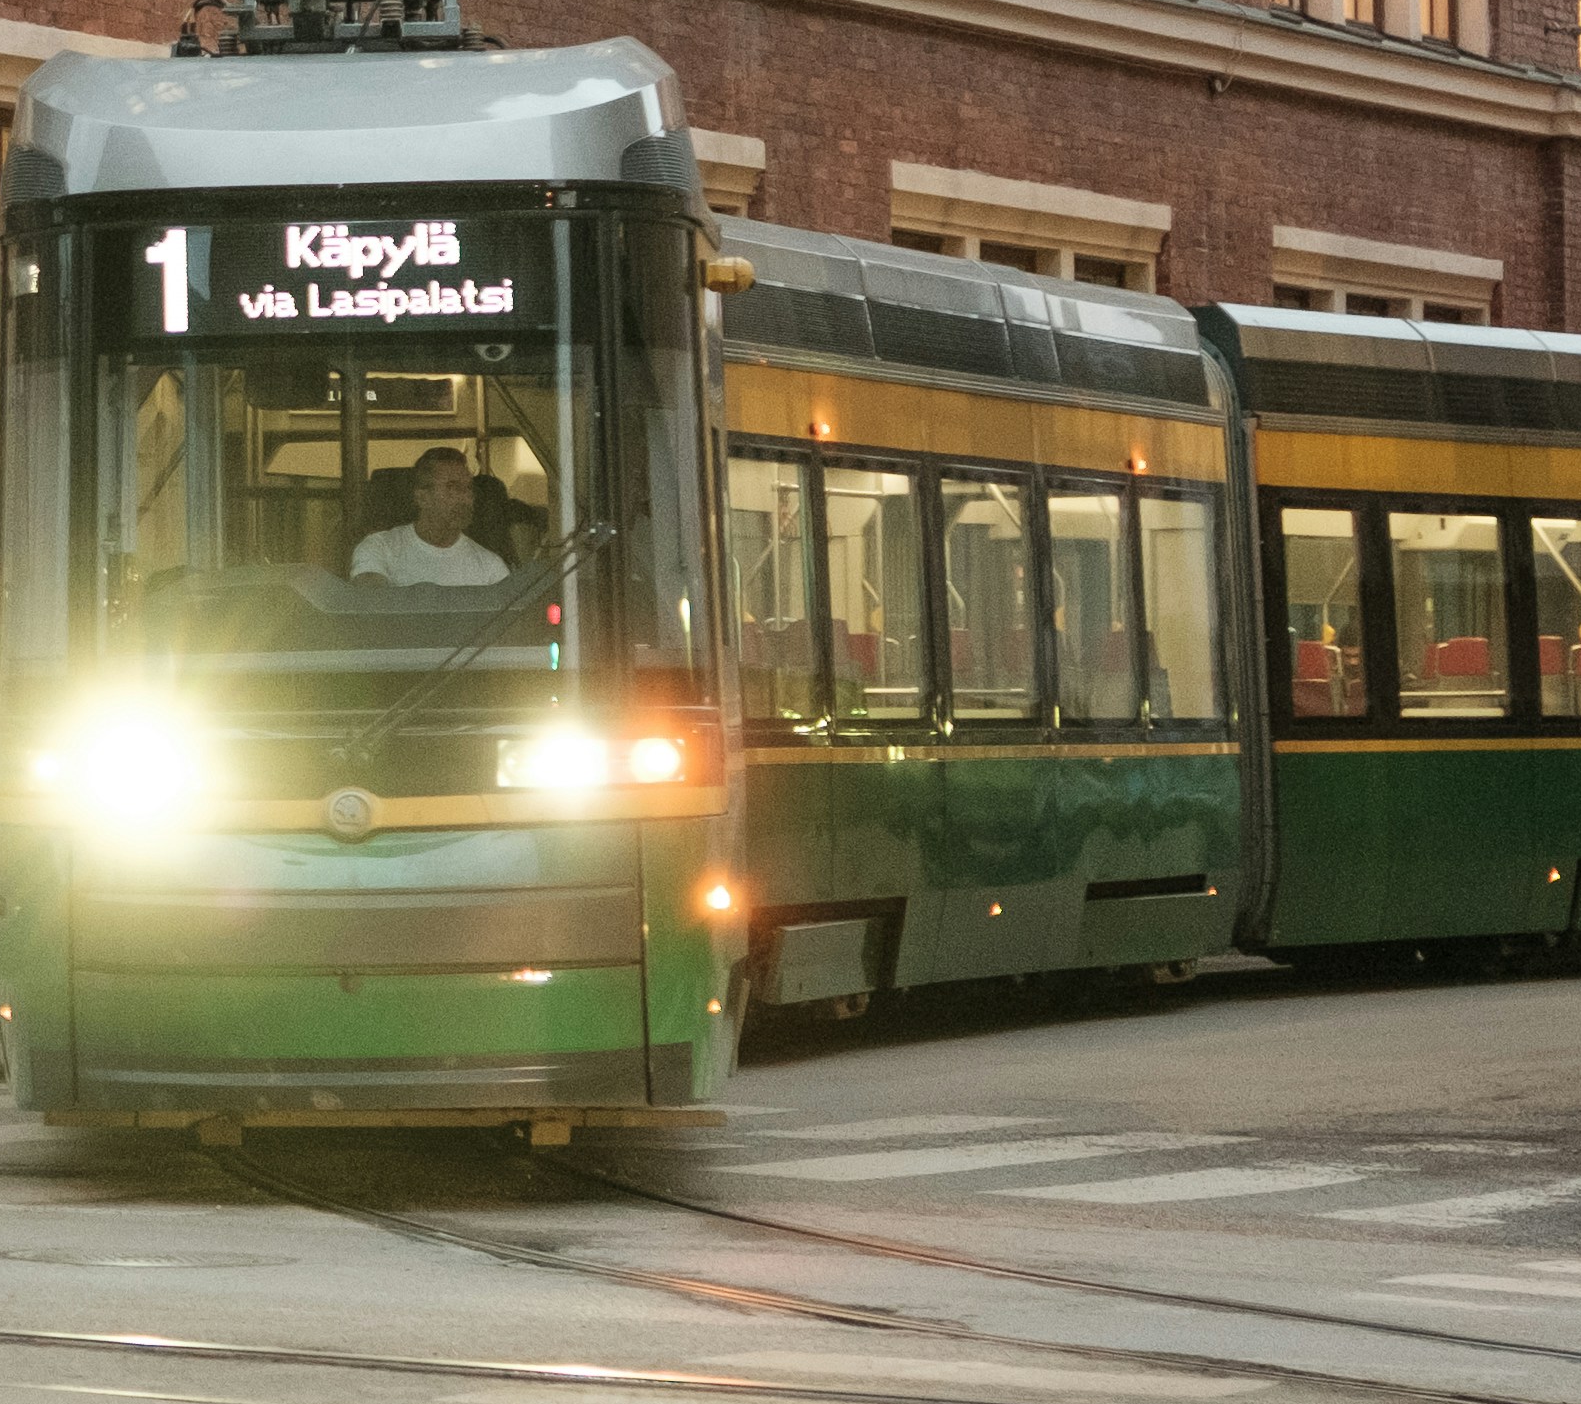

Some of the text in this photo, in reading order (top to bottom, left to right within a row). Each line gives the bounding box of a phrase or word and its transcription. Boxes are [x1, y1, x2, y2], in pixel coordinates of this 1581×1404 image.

[285, 222, 461, 279] Käpylä
[145, 227, 189, 333] 1
[239, 278, 515, 323] via Lasipalatsi
